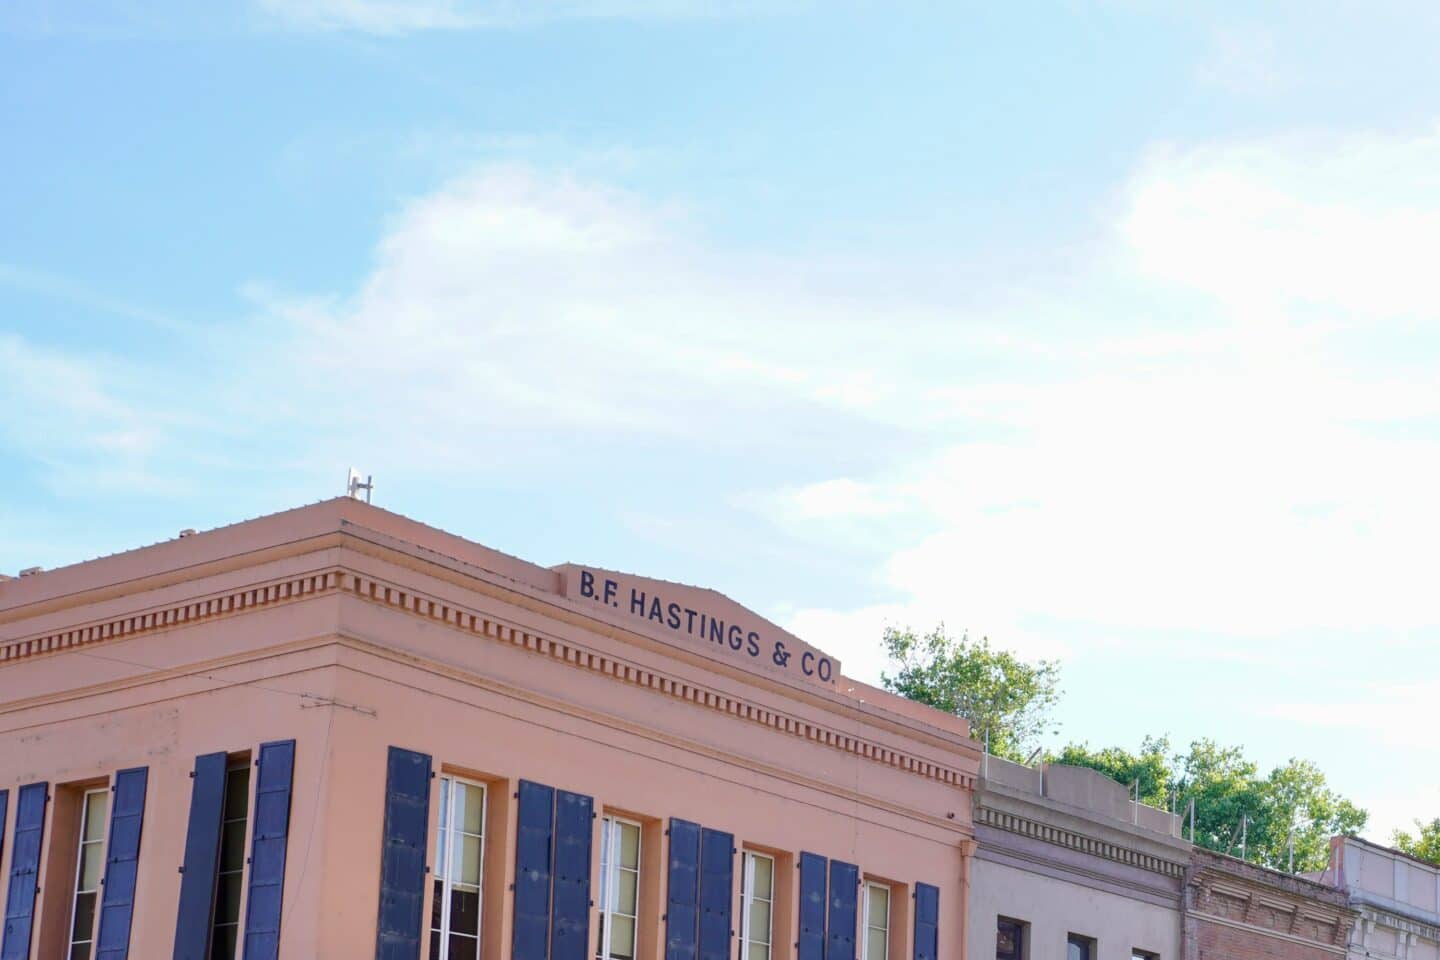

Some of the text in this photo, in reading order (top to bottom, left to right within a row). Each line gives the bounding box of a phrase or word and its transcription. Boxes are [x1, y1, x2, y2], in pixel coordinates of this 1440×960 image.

[580, 570, 836, 684] B.F. HASTINGS & CO.
